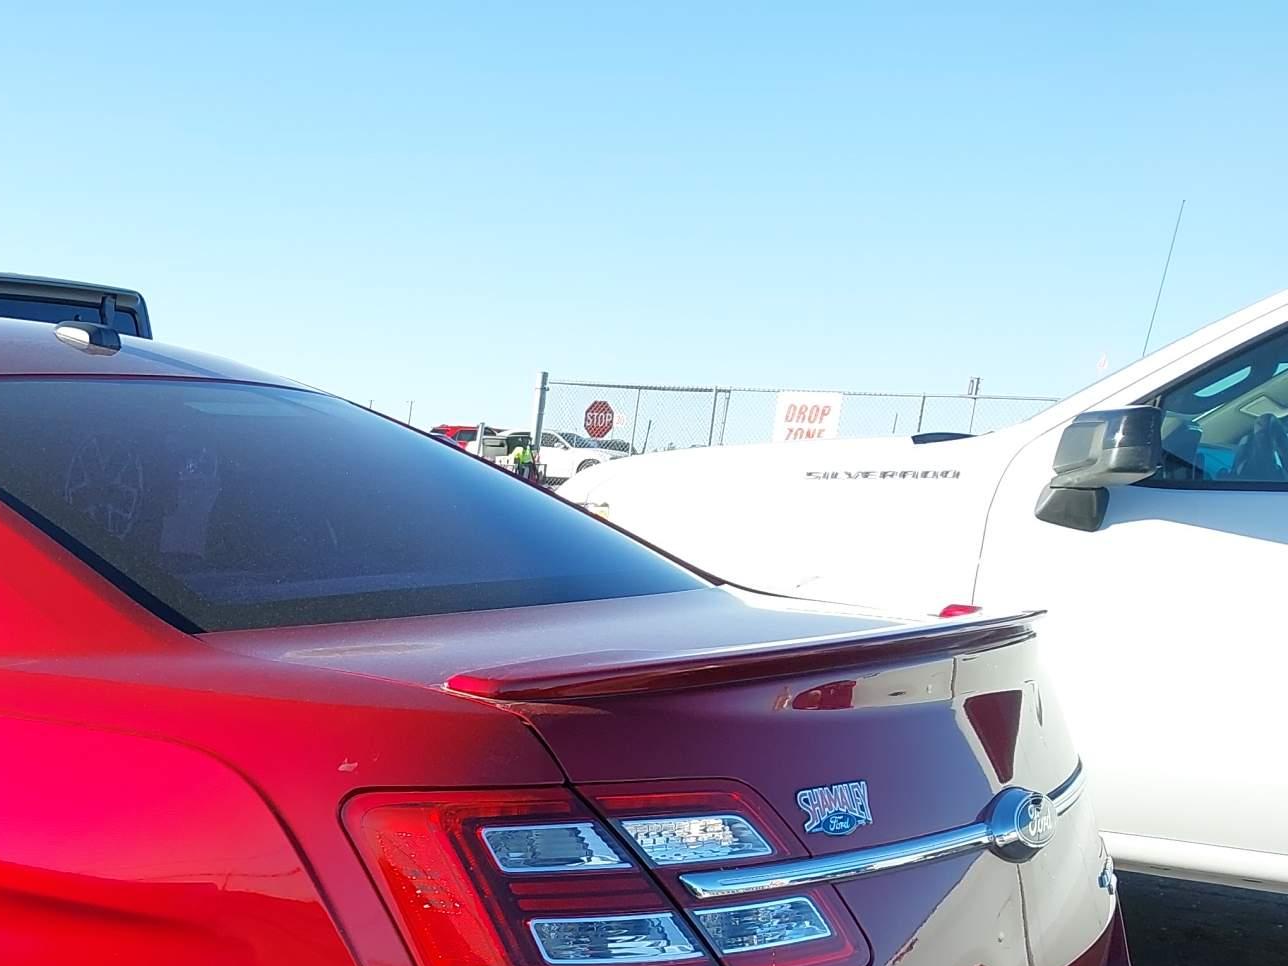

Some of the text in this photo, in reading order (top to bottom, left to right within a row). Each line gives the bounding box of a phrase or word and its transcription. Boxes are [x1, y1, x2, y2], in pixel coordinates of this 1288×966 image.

[586, 412, 612, 426] STOP
[784, 403, 832, 424] DROP
[805, 470, 960, 480] SILVERADO
[797, 781, 872, 832] SHAMALEY
[829, 815, 852, 831] Ford
[1028, 803, 1053, 837] Ford
